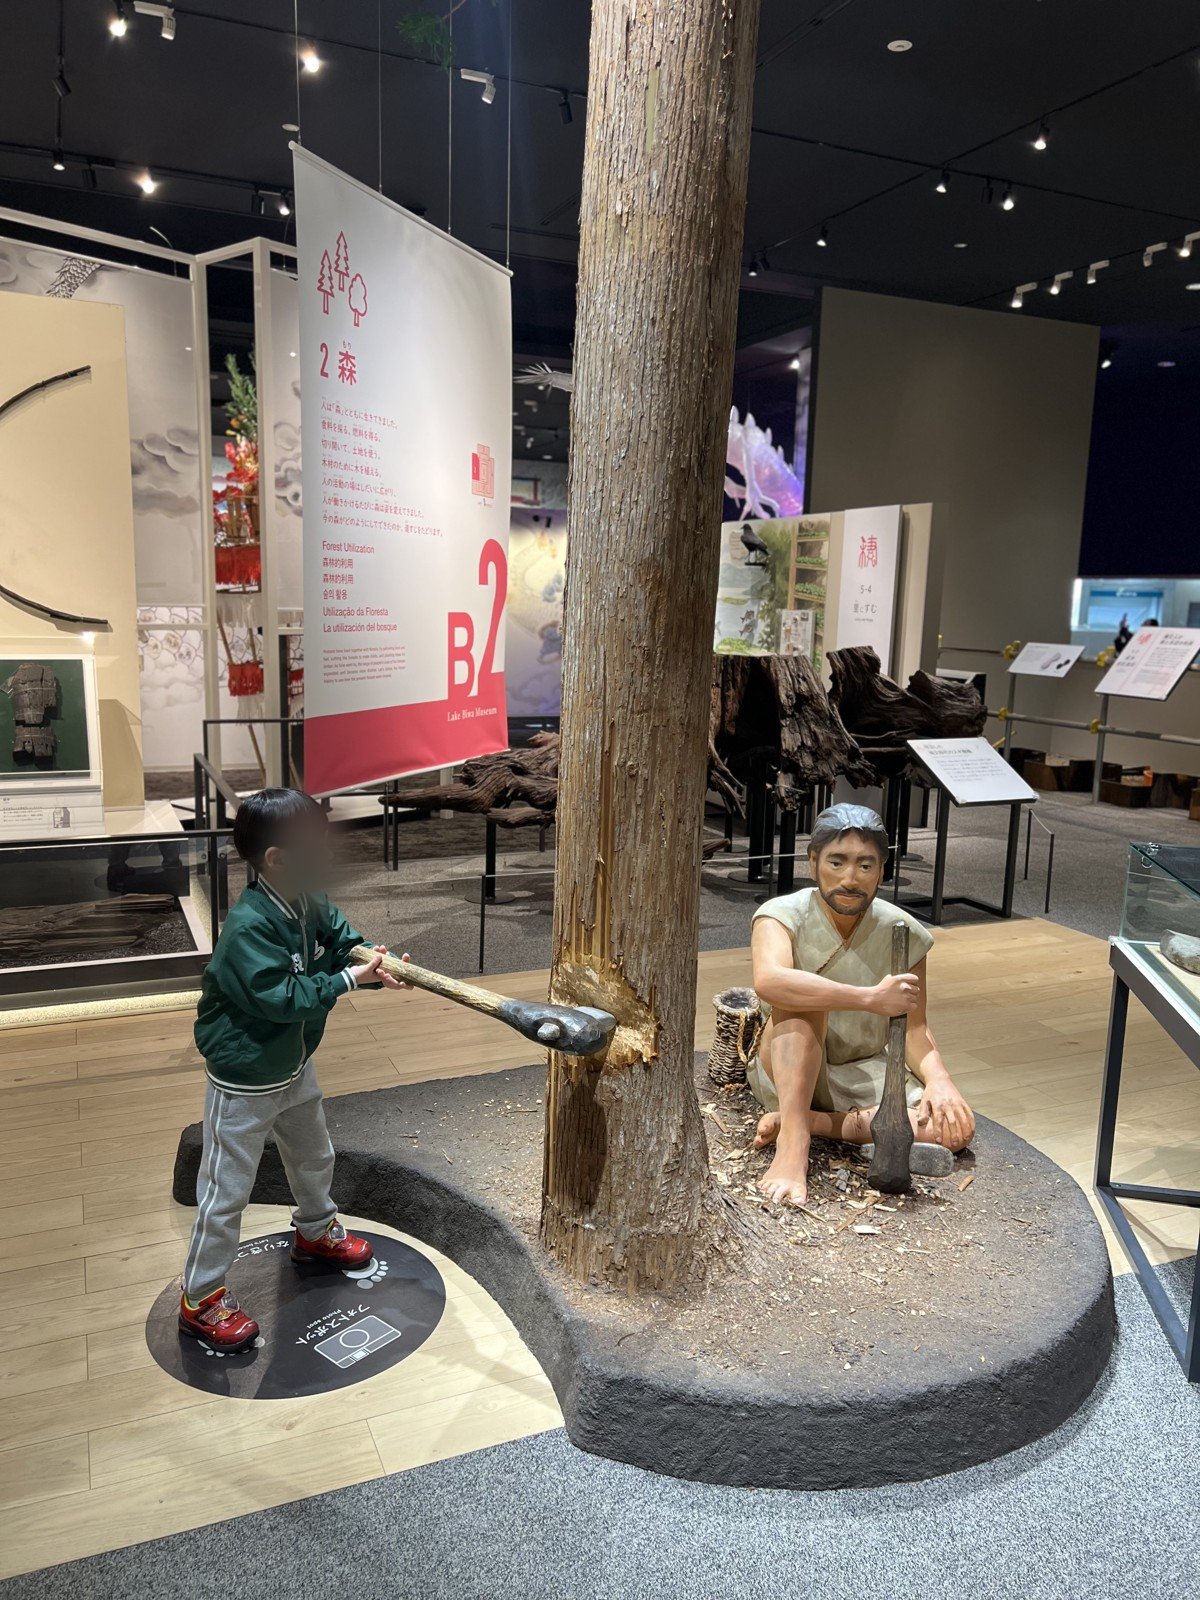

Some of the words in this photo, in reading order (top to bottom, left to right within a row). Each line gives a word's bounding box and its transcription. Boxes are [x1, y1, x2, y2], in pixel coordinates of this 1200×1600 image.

[320, 342, 329, 378] 2
[338, 350, 357, 385] 森
[322, 540, 343, 552] Forest
[344, 543, 375, 555] Utilization
[322, 557, 354, 569] 森林的利用
[322, 573, 354, 585] 森林的利用
[323, 589, 335, 600] 숲의
[860, 585, 872, 594] 5-4
[322, 606, 355, 618] Utilização
[356, 607, 365, 616] da
[365, 606, 389, 617] Floresta
[323, 623, 332, 633] La
[332, 622, 365, 633] utilización
[366, 622, 376, 632] del
[376, 621, 398, 633] bosque
[447, 711, 461, 721] Lake
[461, 708, 475, 719] Biwa
[475, 707, 498, 718] Museum
[321, 1308, 342, 1321] Photo
[295, 1304, 371, 1345] フォトスポット
